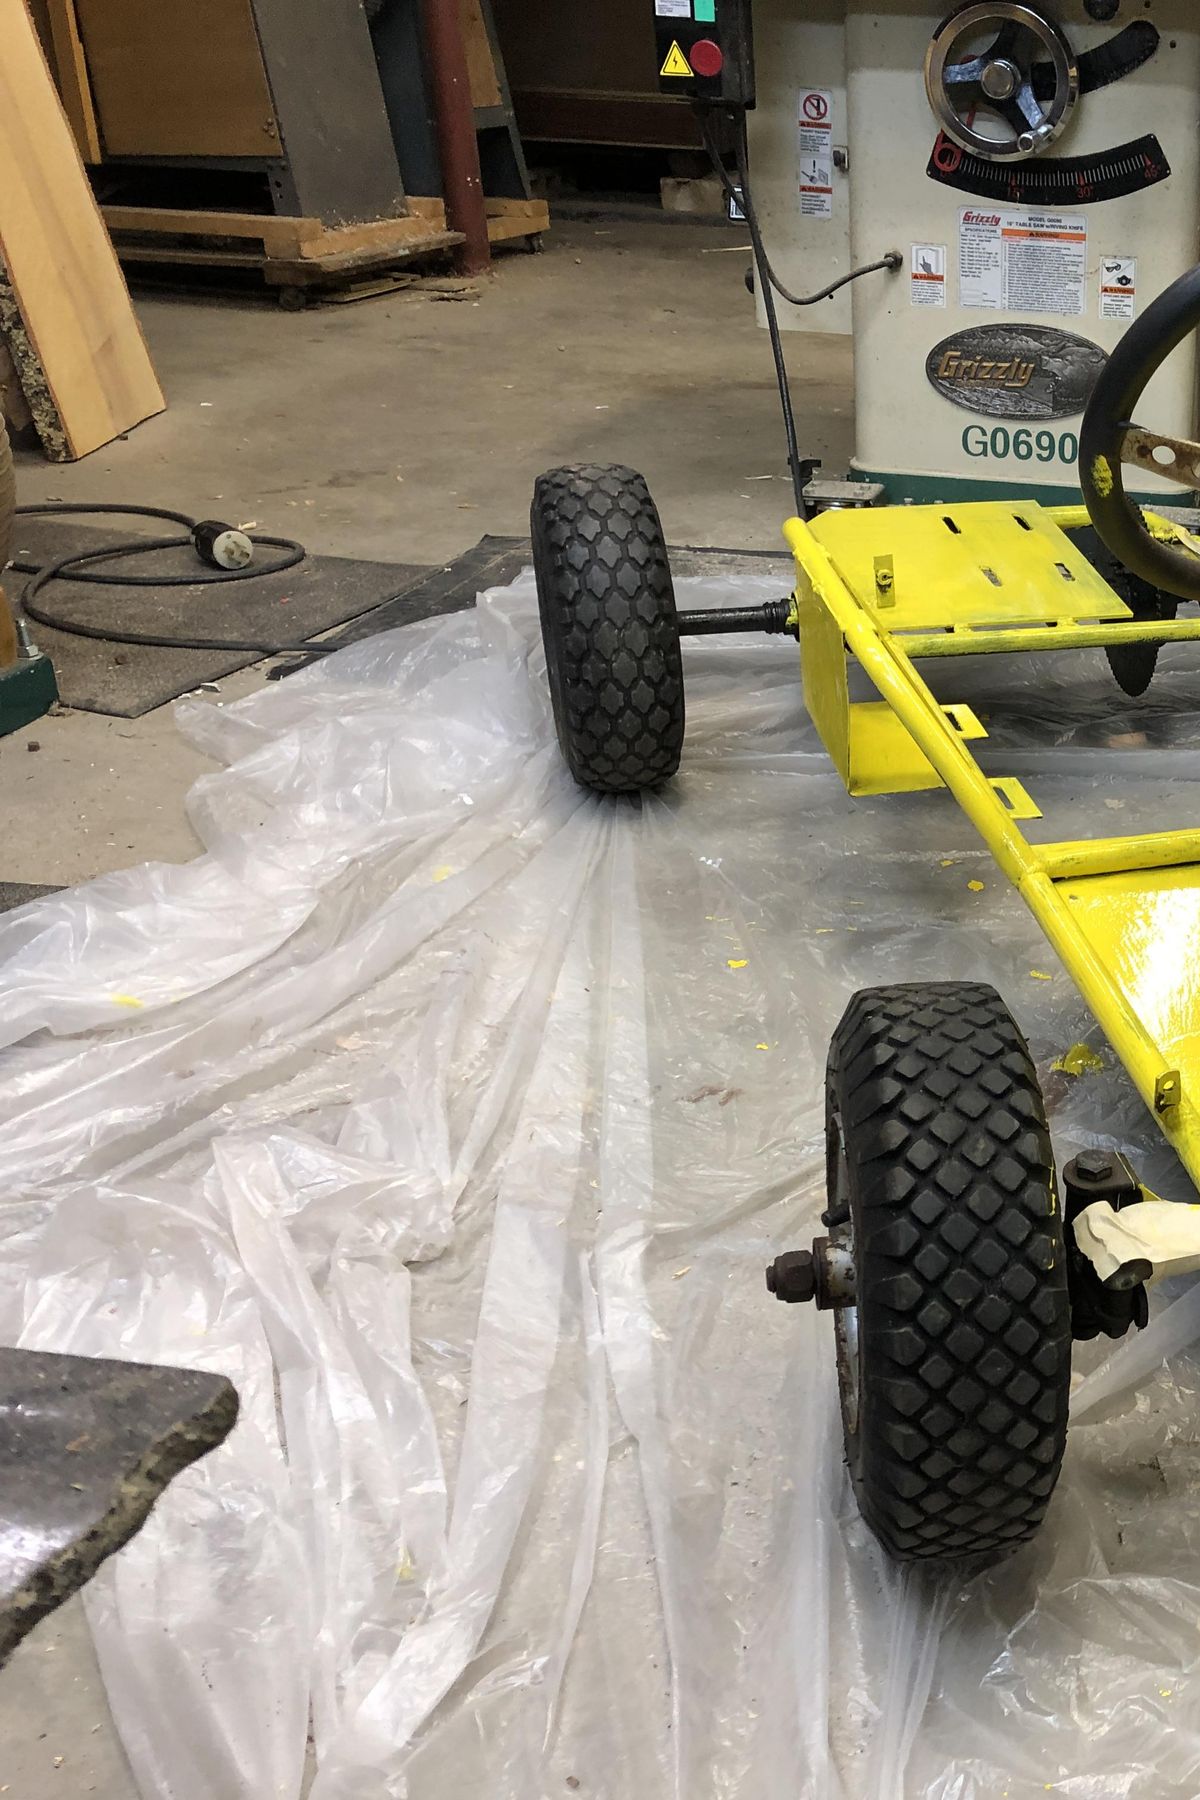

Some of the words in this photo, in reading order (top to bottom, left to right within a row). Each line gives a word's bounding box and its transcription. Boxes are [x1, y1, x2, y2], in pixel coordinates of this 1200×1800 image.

[962, 211, 1001, 226] Grizzly
[938, 351, 1035, 387] Grizzly
[961, 424, 1078, 464] G0690
